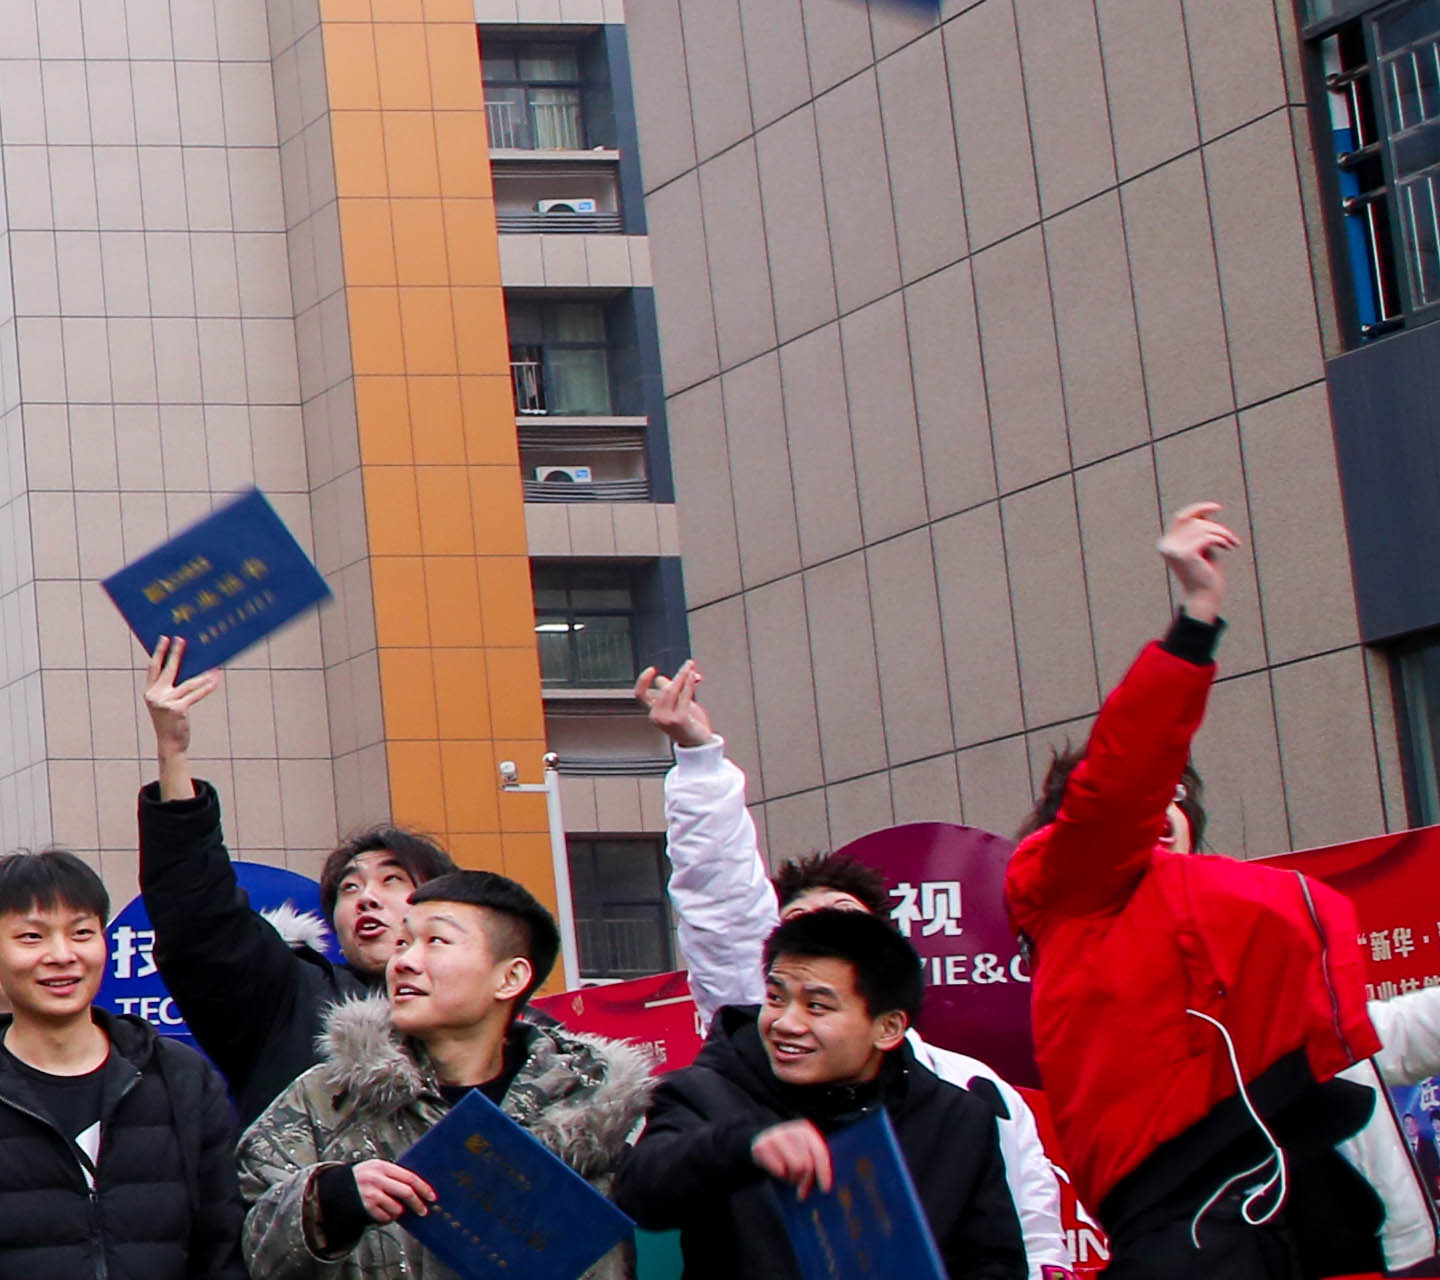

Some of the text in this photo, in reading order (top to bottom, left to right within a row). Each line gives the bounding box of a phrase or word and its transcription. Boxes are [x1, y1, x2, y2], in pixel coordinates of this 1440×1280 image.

[889, 881, 963, 937] 视
[111, 926, 158, 978] 技
[114, 996, 184, 1025] TEC
